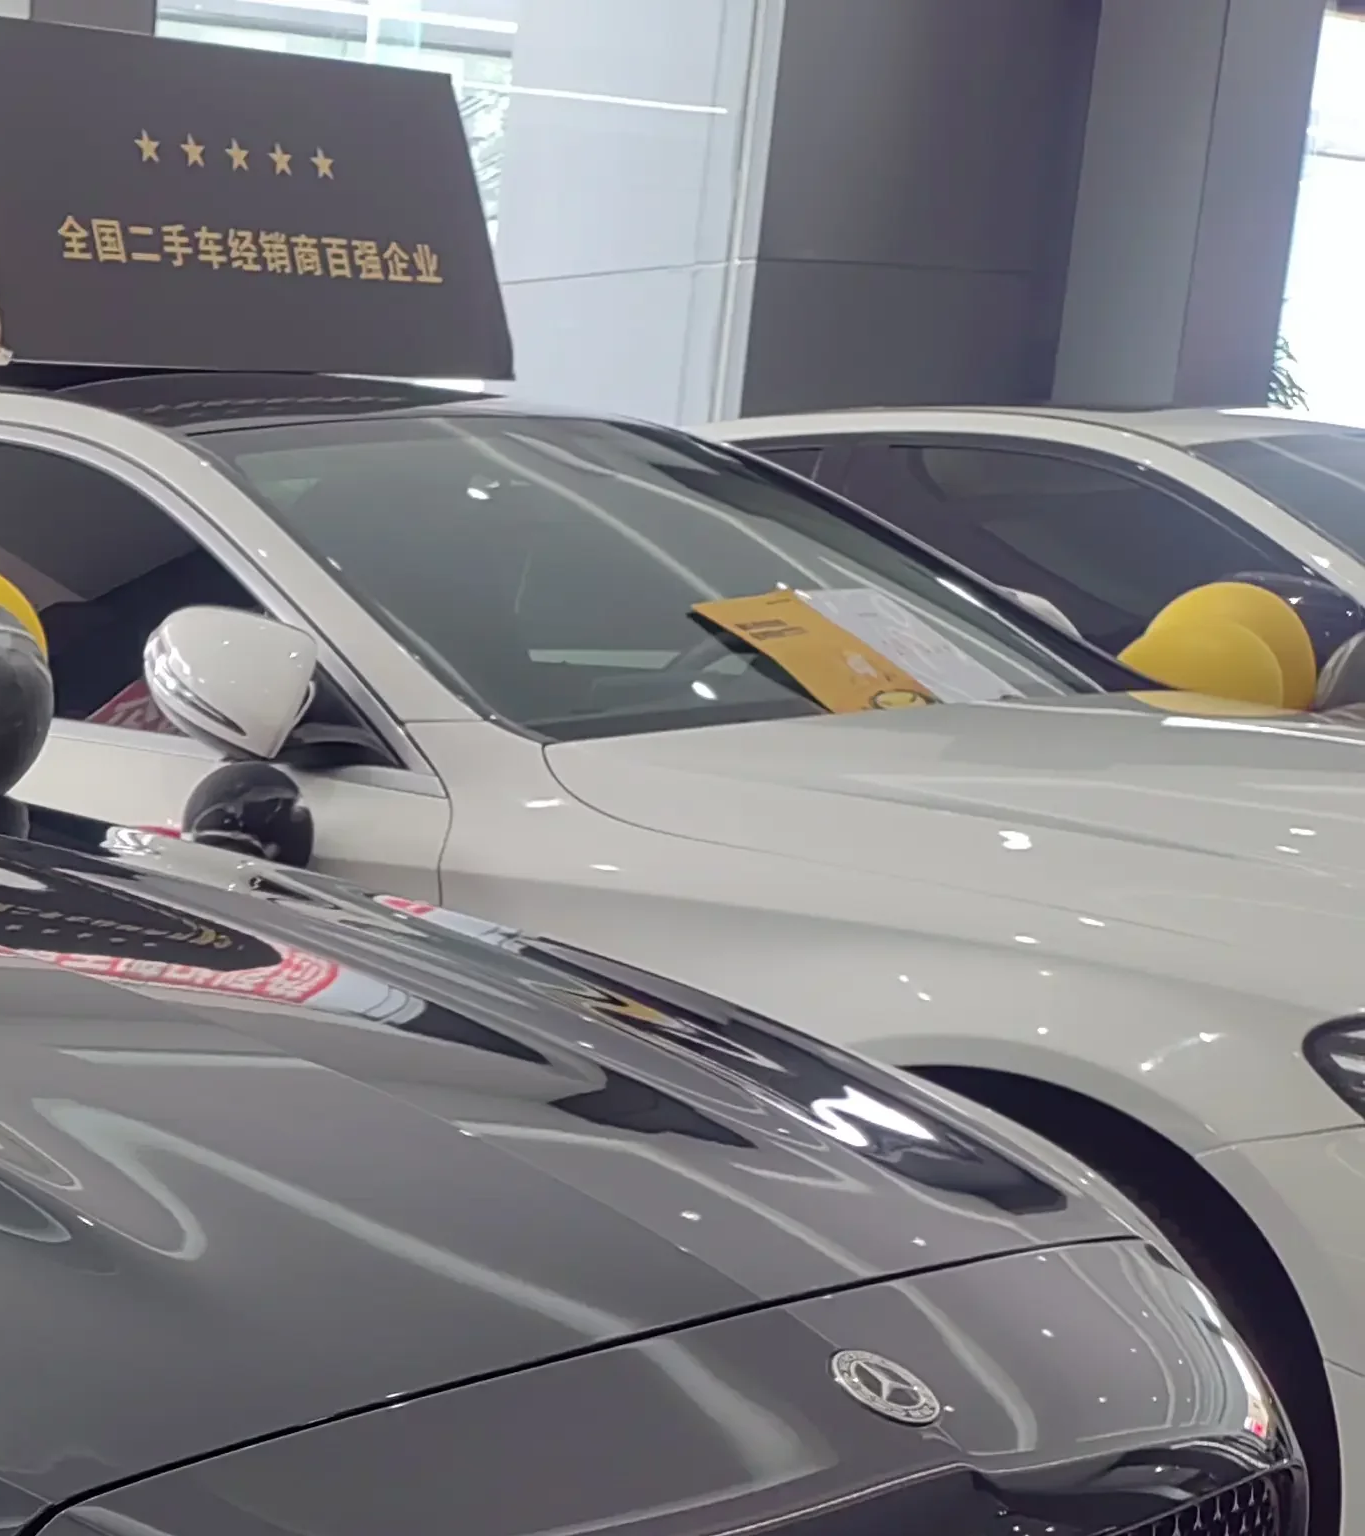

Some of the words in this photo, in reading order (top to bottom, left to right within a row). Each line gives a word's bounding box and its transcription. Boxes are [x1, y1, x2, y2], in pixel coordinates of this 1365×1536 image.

[57, 214, 444, 286] 全国二手车经销商百强企业
